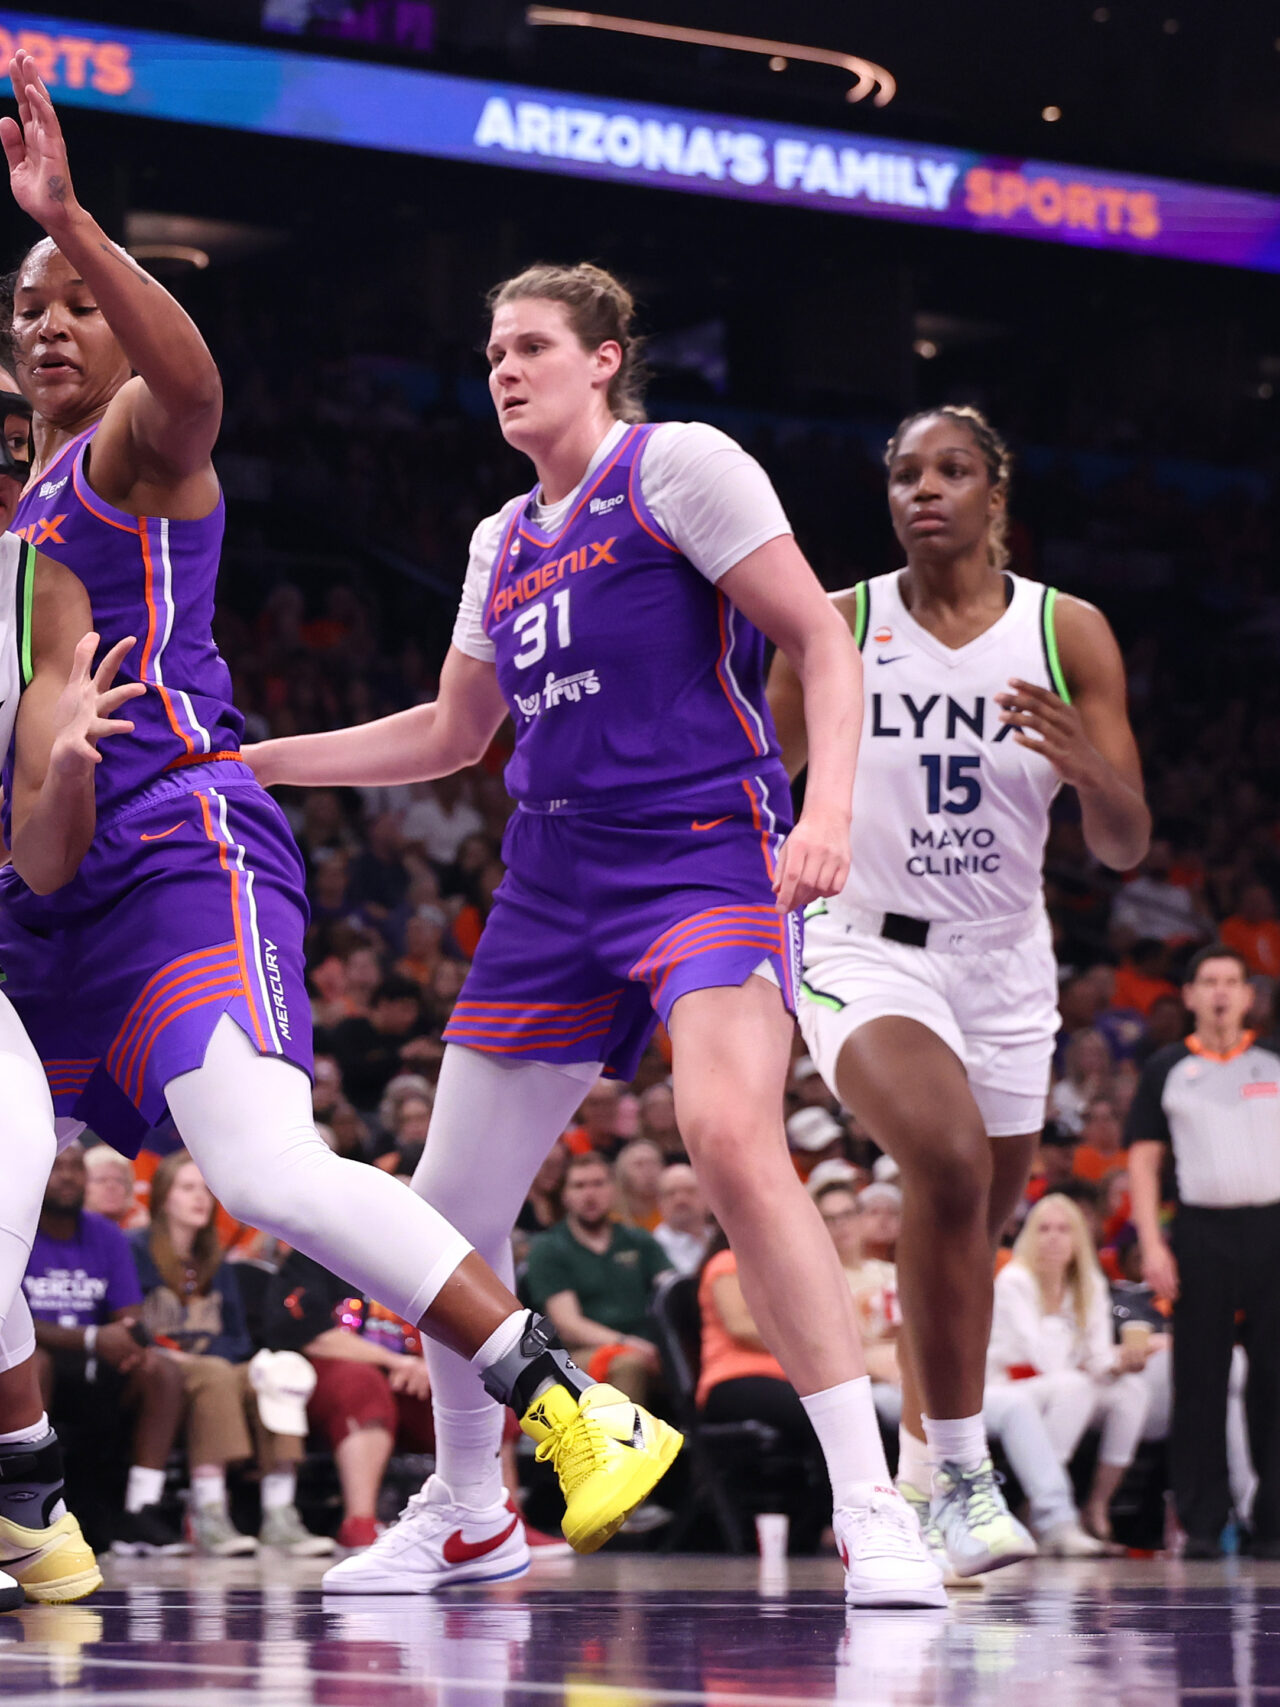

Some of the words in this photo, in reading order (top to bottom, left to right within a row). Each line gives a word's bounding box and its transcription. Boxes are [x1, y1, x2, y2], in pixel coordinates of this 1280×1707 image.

[474, 96, 768, 186] ARIZONA'S
[774, 139, 959, 211] FAMILY
[964, 166, 1161, 238] SPORTS
[492, 536, 619, 622] PHOENIX
[513, 588, 572, 670] 31
[920, 754, 982, 815] 15
[906, 853, 1001, 877] CLINIC
[910, 827, 995, 850] MAYO
[263, 937, 293, 1042] MERCURY
